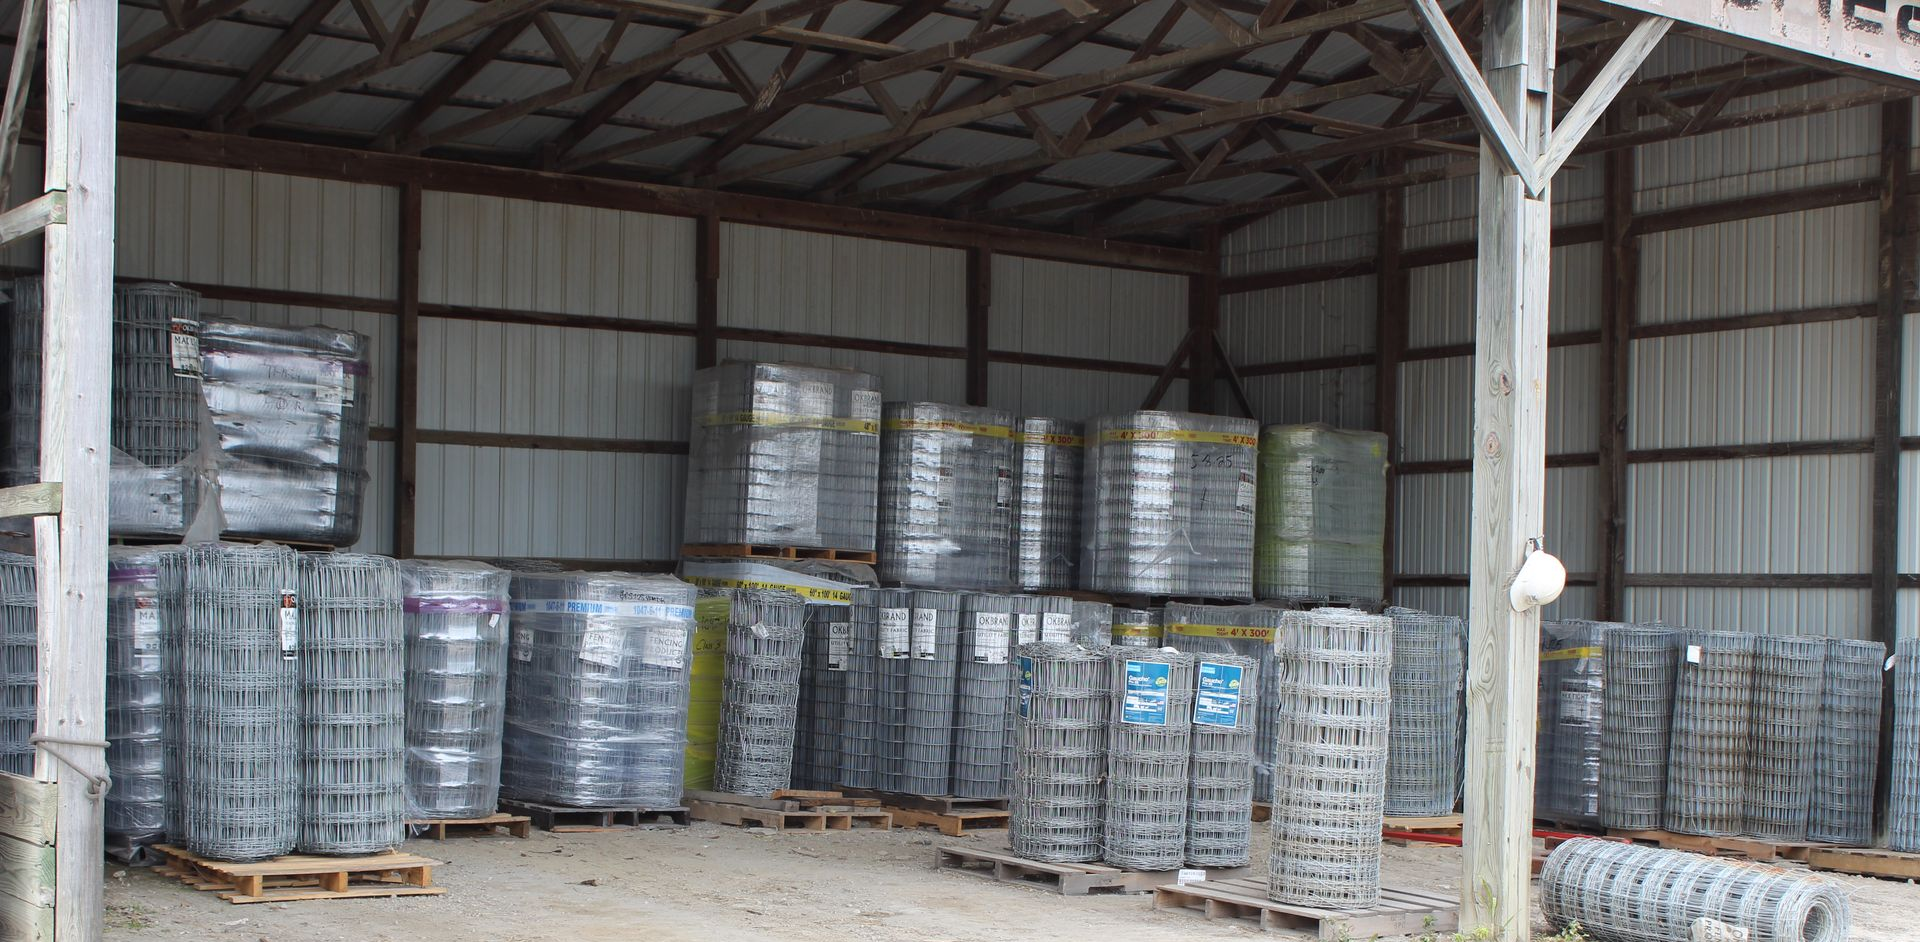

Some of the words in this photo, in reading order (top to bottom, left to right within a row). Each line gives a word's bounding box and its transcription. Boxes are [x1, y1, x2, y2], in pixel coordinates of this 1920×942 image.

[567, 602, 602, 613] PREMIUM
[1230, 628, 1238, 637] 4'
[1241, 629, 1248, 637] X
[1249, 629, 1269, 637] 300'
